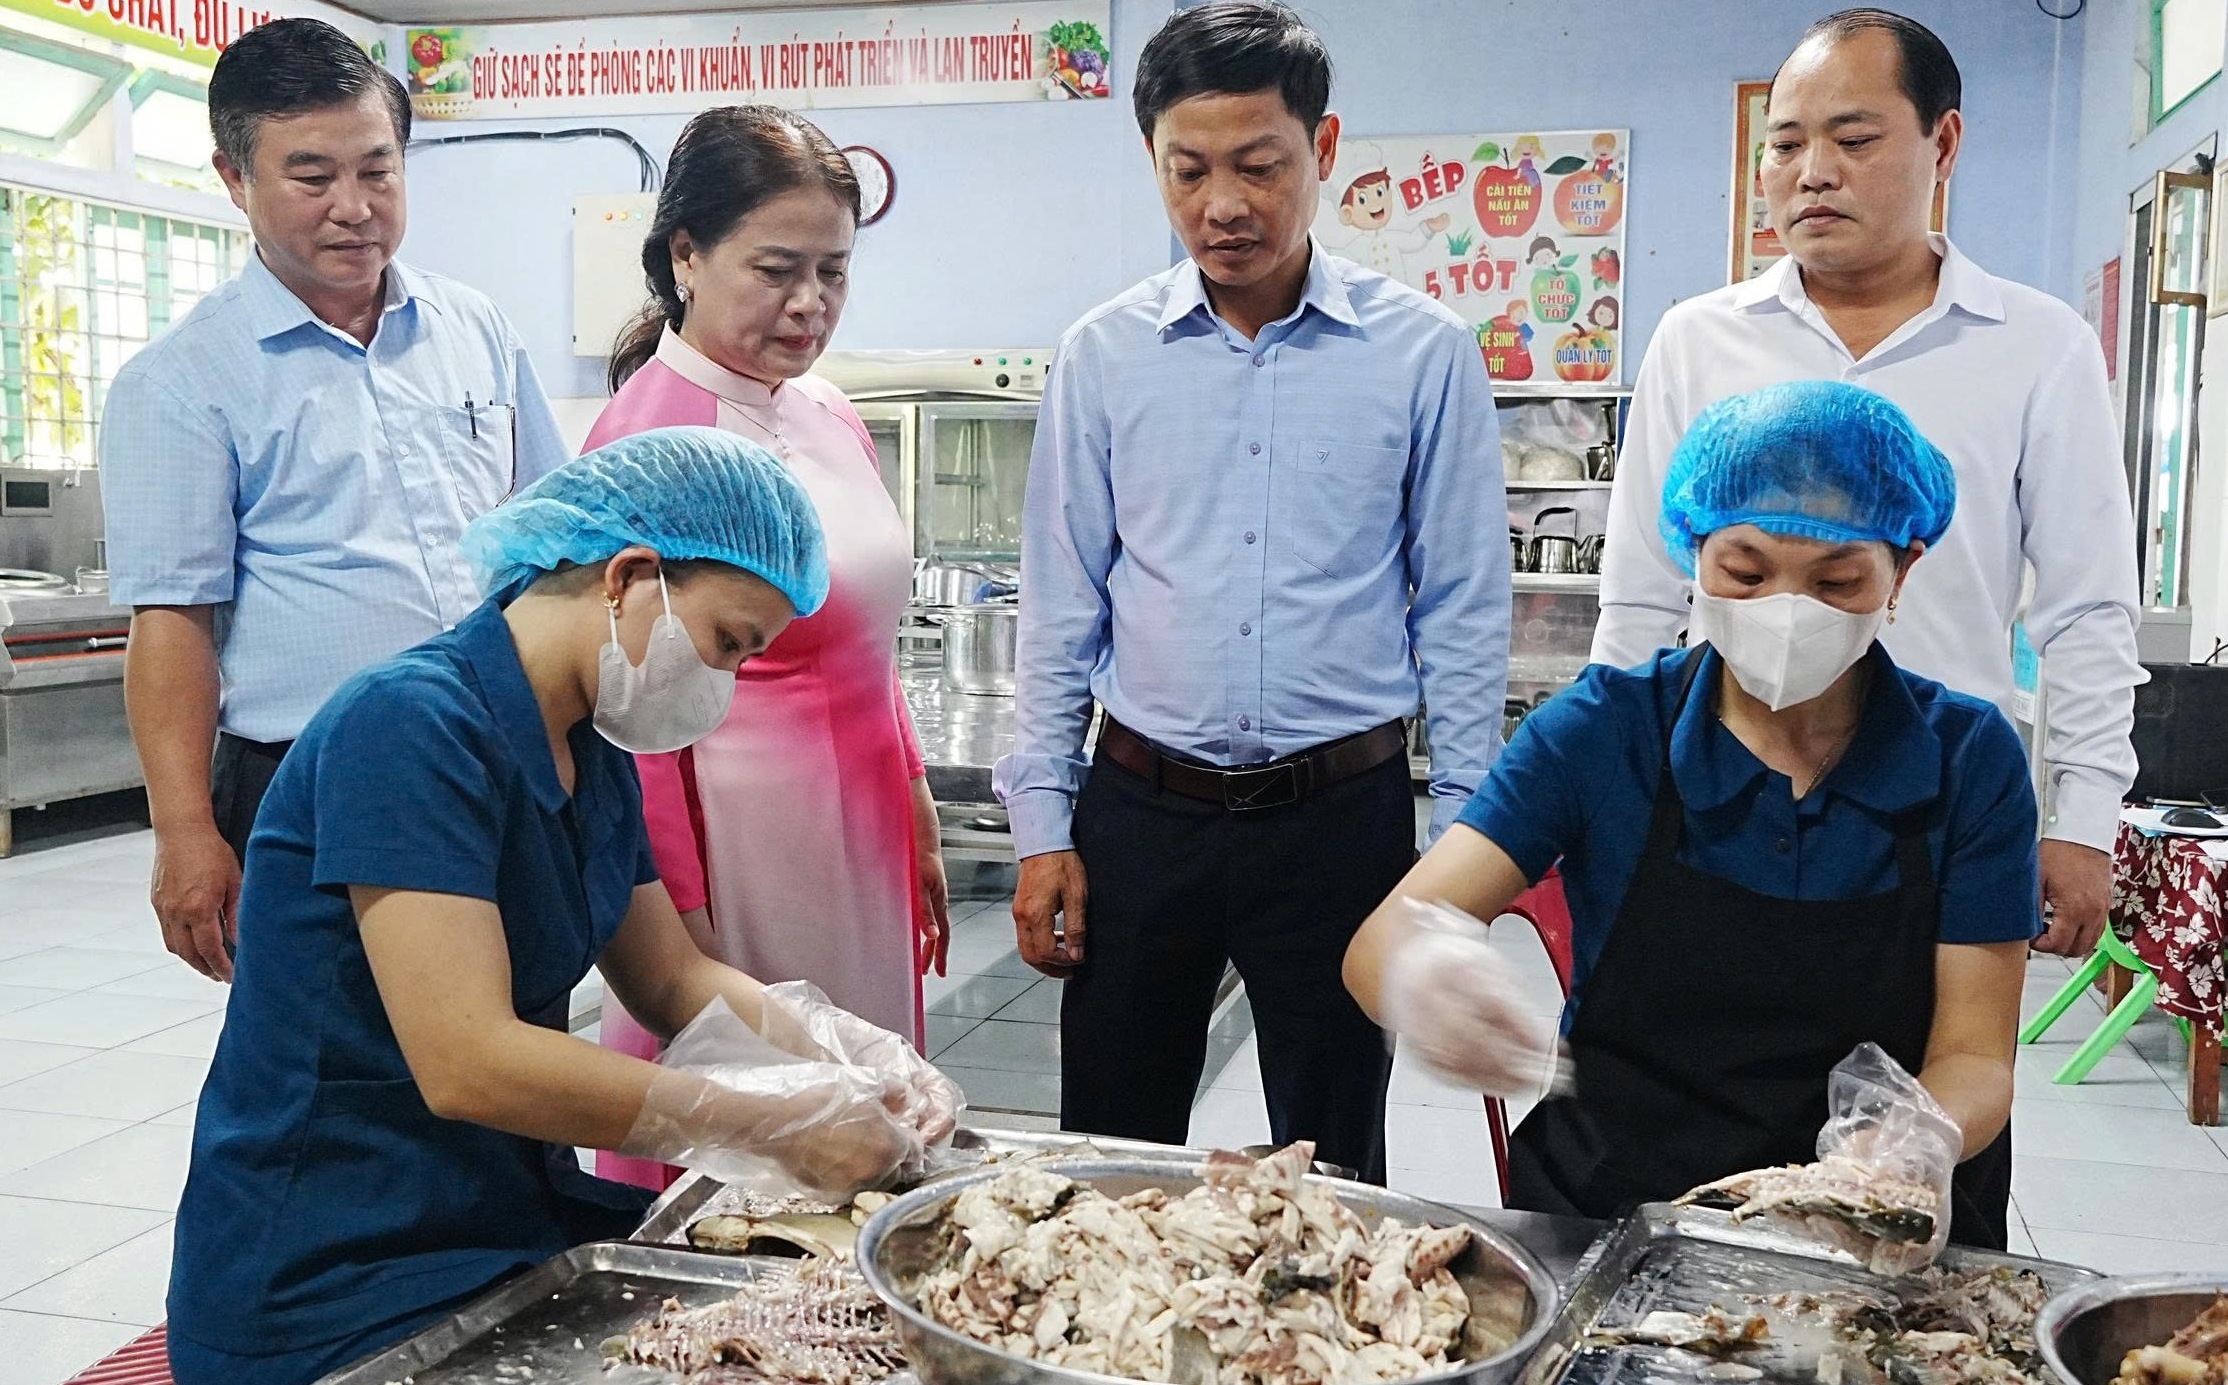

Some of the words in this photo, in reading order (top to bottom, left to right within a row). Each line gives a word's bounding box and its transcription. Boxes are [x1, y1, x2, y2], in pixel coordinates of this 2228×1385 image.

[501, 54, 539, 109] SẠCH
[591, 39, 641, 95] PHÒNG
[646, 39, 676, 94] CÁC
[680, 47, 694, 92] VI
[700, 26, 756, 96] KHUẨN,
[760, 44, 774, 90] VI
[780, 33, 809, 89] RÚT
[814, 31, 854, 88] PHÁT
[858, 20, 904, 86] TRIỂN
[909, 27, 929, 84] VÀ
[934, 37, 965, 83] LAN
[1399, 153, 1464, 210] BẾP
[1425, 270, 1442, 299] 5
[1448, 244, 1517, 294] TỐT
[1492, 332, 1515, 348] SINH
